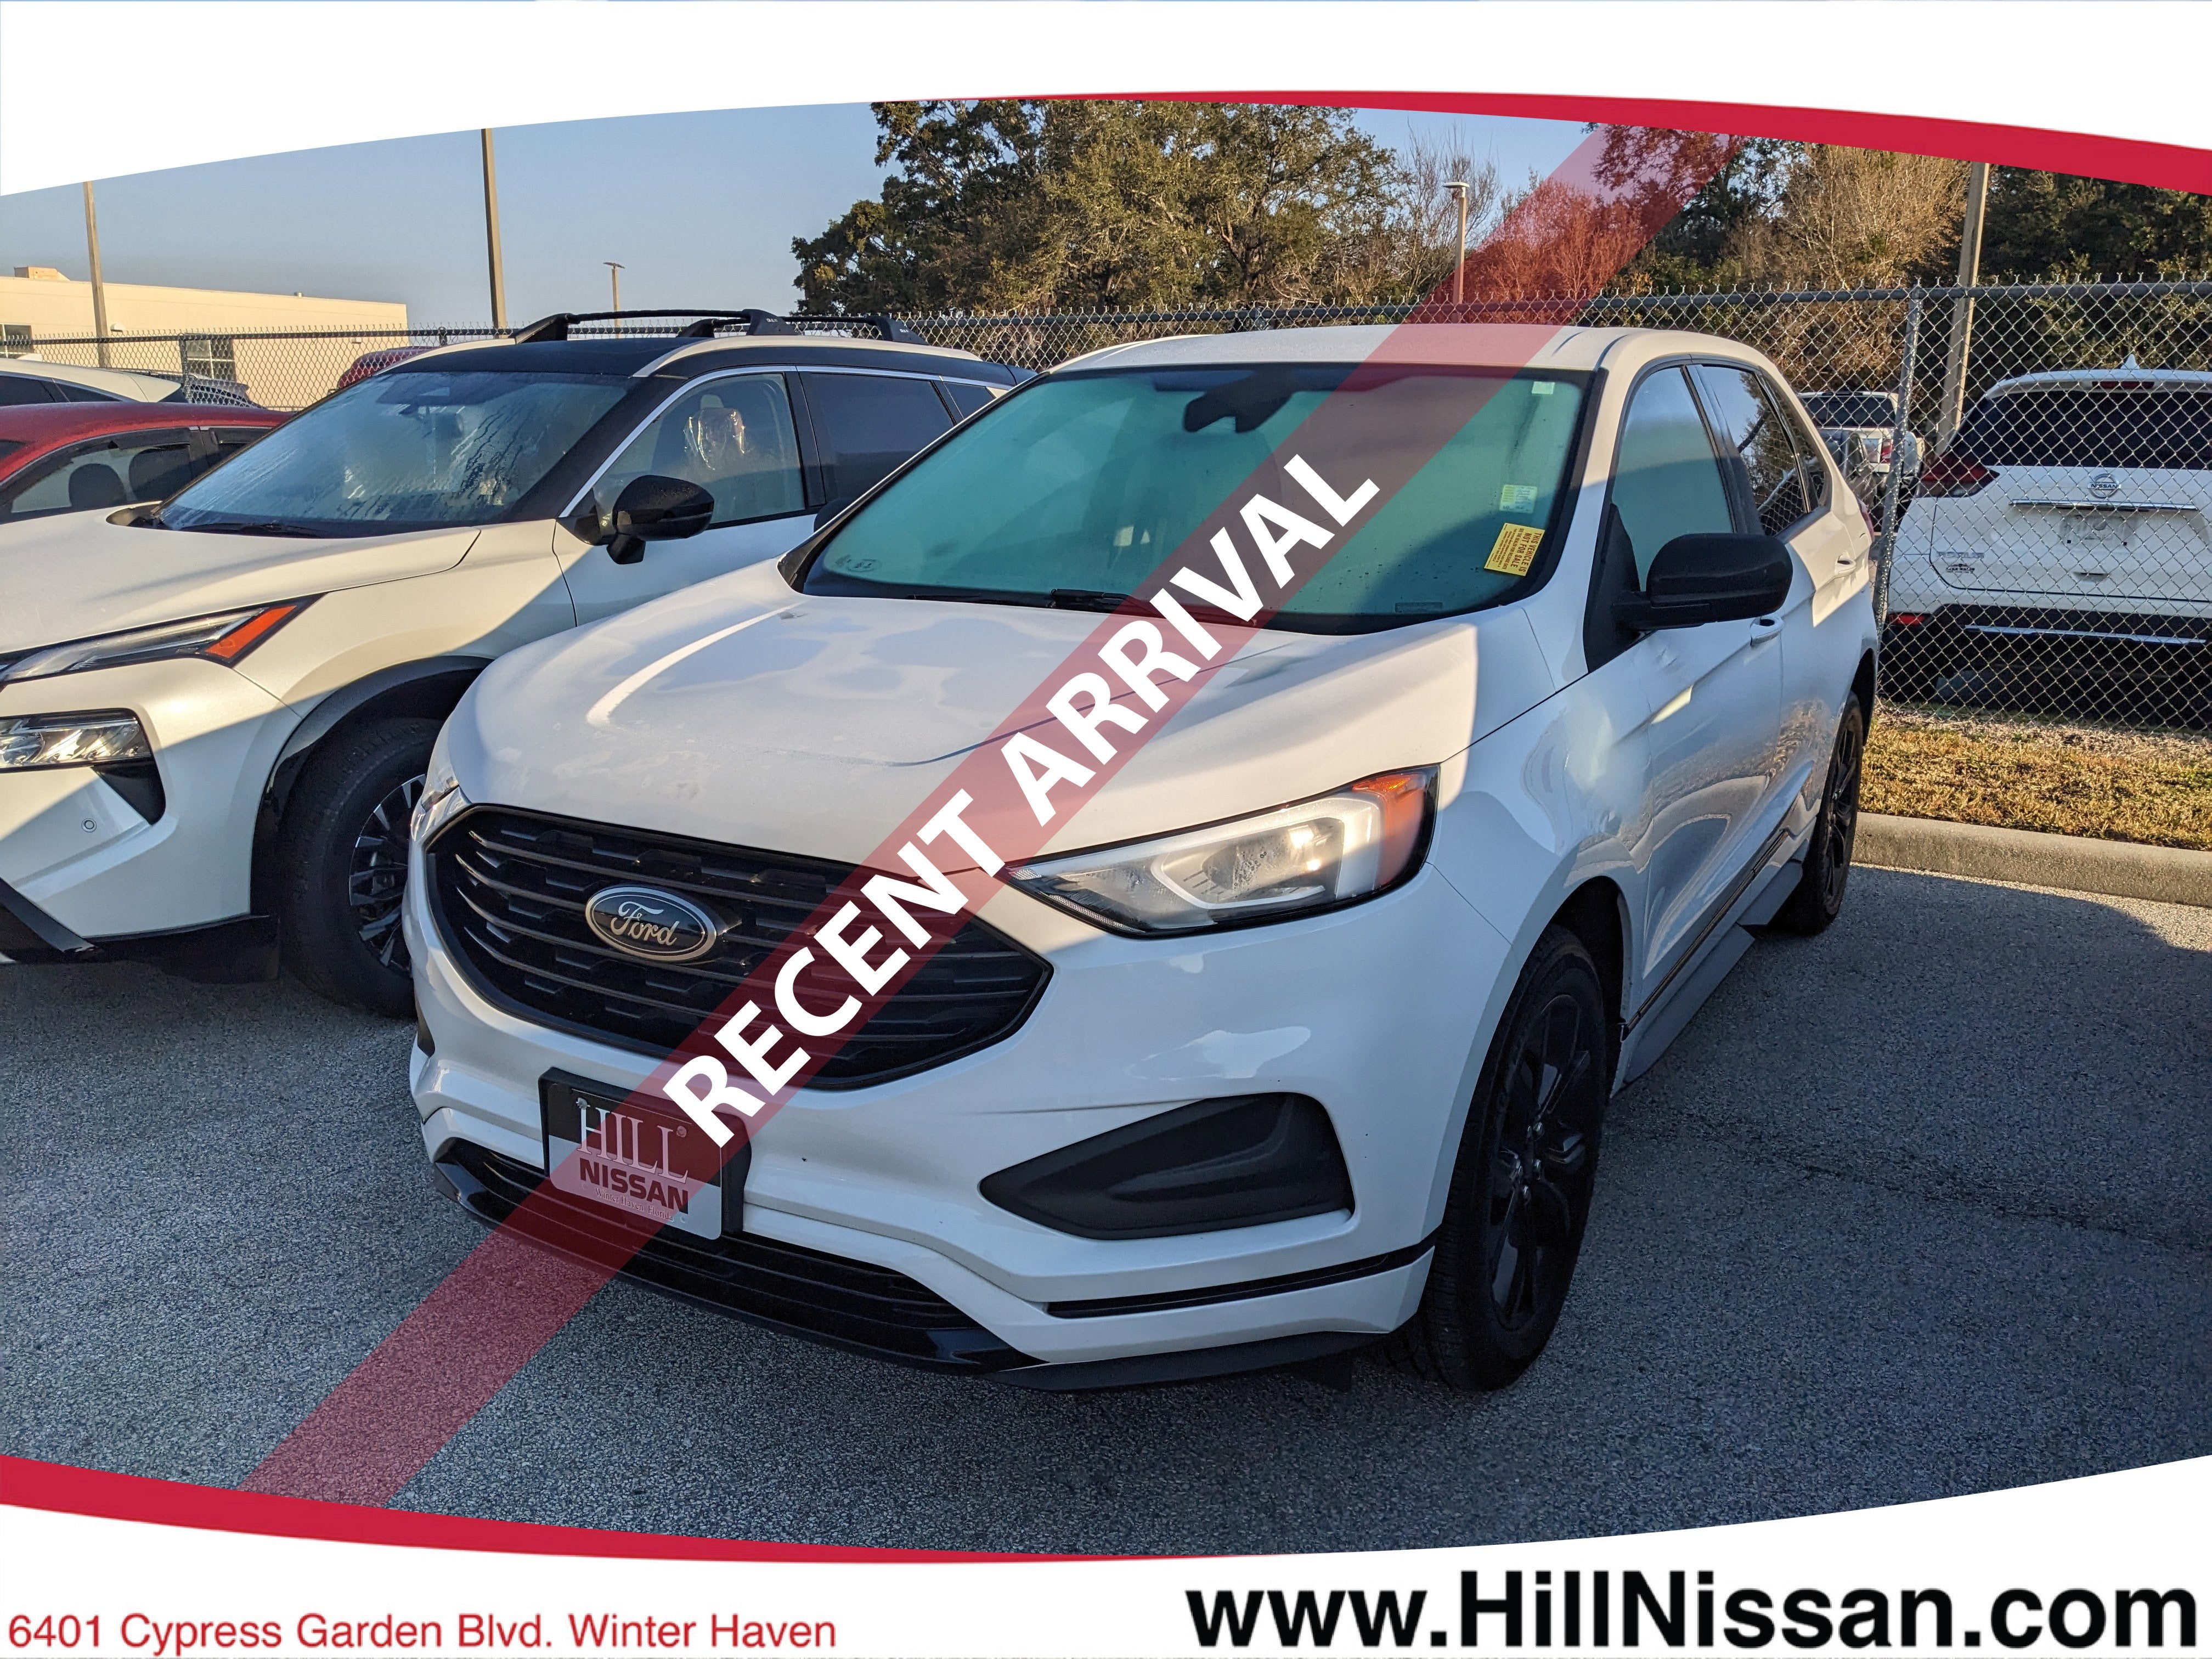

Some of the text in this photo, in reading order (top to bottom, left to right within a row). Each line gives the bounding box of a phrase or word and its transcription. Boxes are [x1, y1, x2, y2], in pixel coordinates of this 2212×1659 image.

[1510, 532, 1532, 568] NOT FOR SALE
[1521, 544, 1537, 566] VEHICLE
[1530, 532, 1542, 544] THIS
[611, 900, 680, 946] Ford
[576, 1098, 688, 1184] HILL
[580, 1157, 689, 1215] NISSAN
[595, 1187, 674, 1221] Winter Haven Florida
